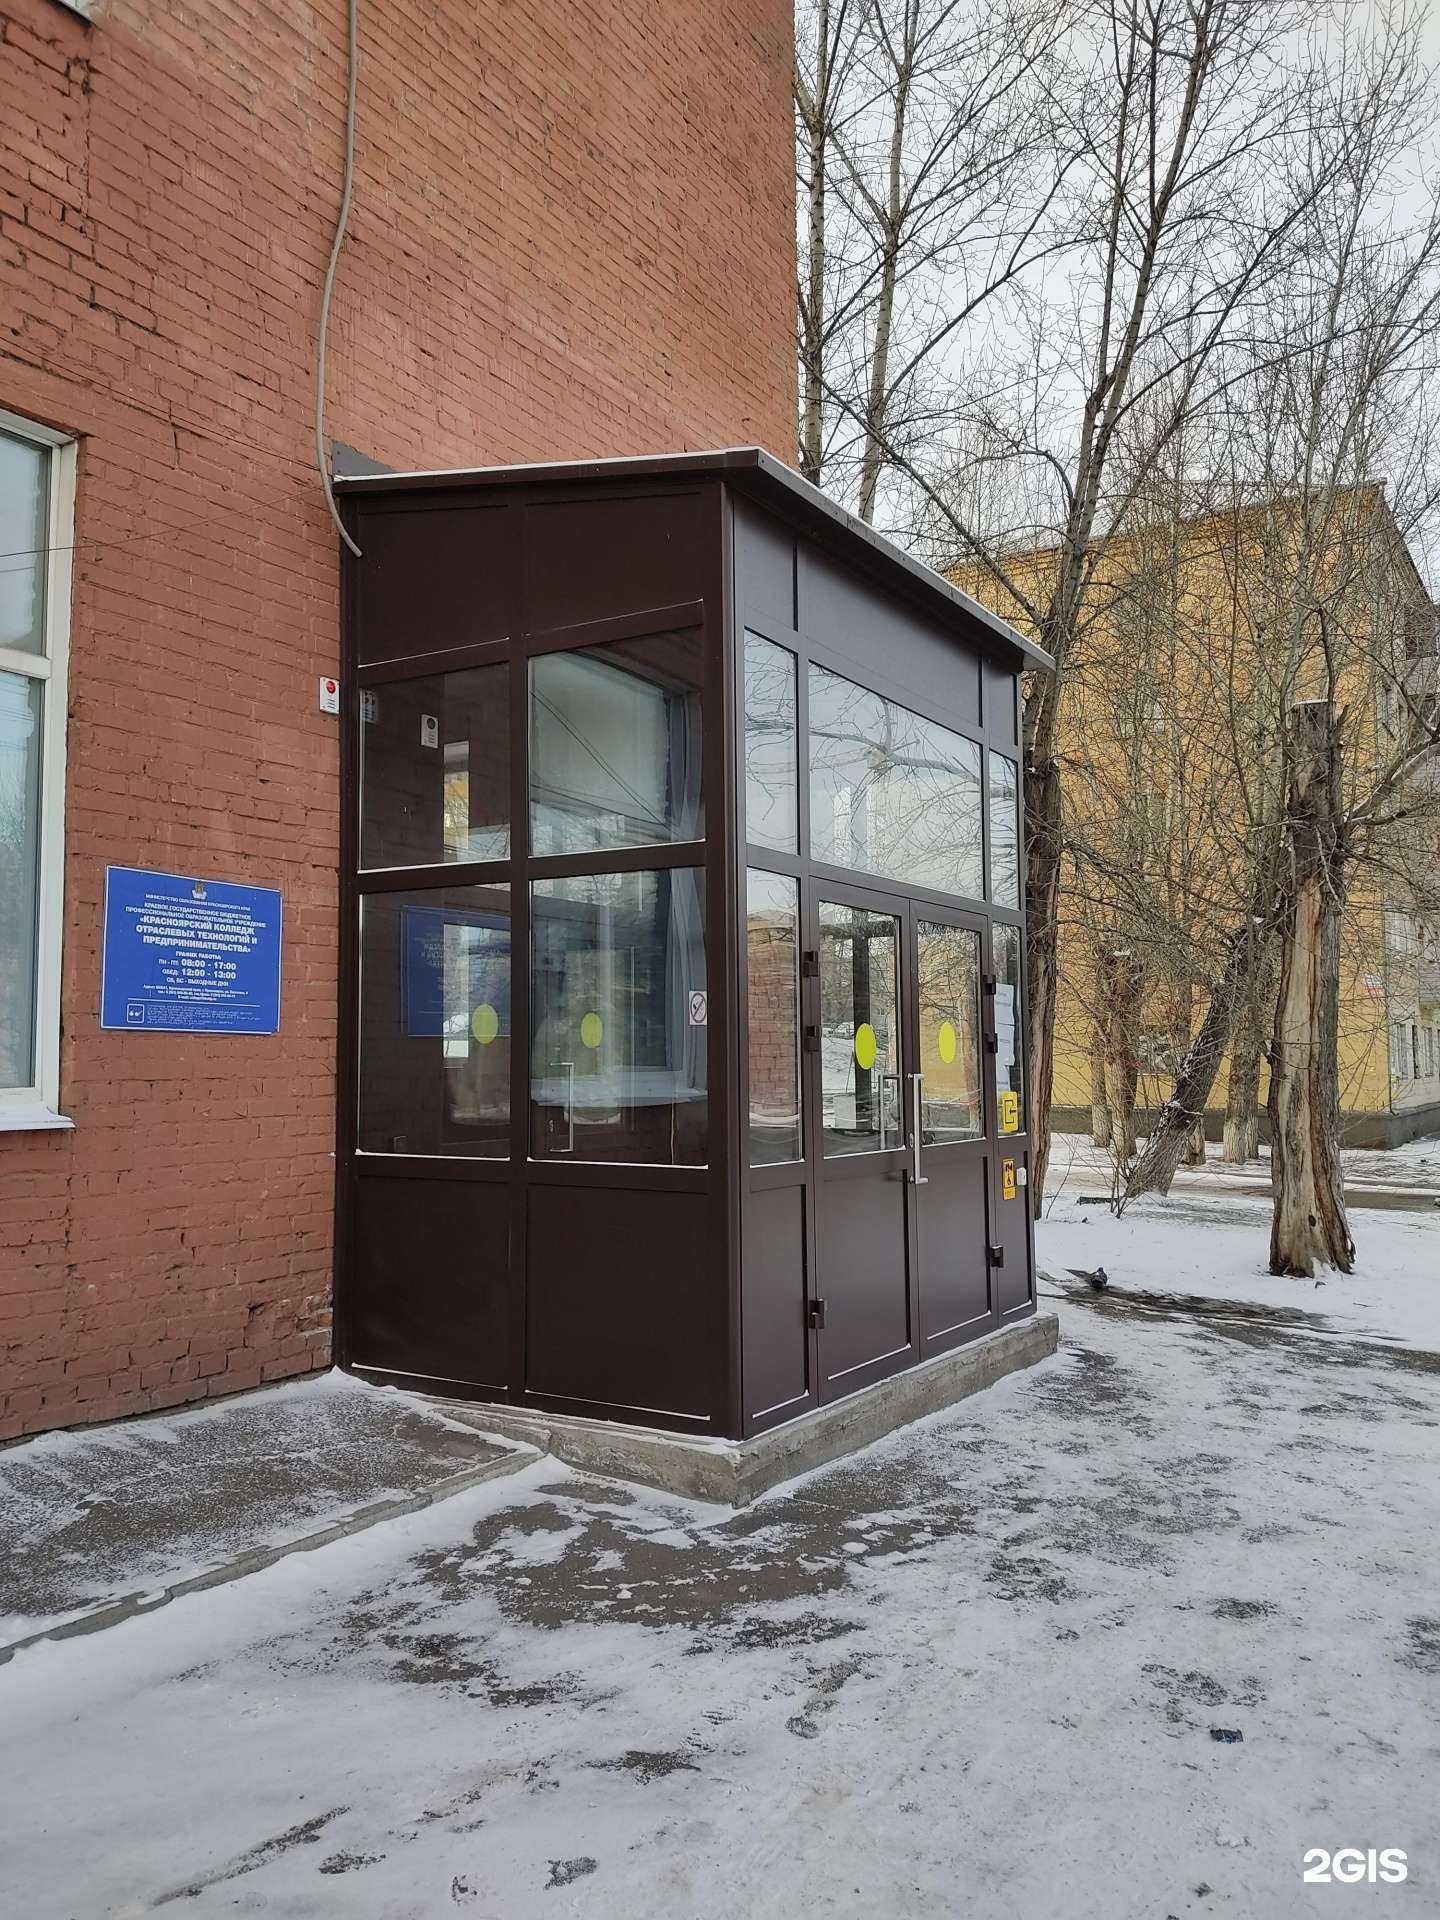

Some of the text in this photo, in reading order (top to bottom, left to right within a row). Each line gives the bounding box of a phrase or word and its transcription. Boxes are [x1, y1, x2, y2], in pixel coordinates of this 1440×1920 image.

[140, 914, 255, 935] «КРАСНОЯРСКИЙ КОЛЛЕДЖ
[136, 924, 258, 945] ОТРАСЛЕВЫХ ТЕХНОЛОГИЙ И
[181, 958, 206, 968] 08:00
[214, 961, 237, 970] 17:00
[181, 968, 206, 977] 12:00
[214, 970, 237, 979] 13:00
